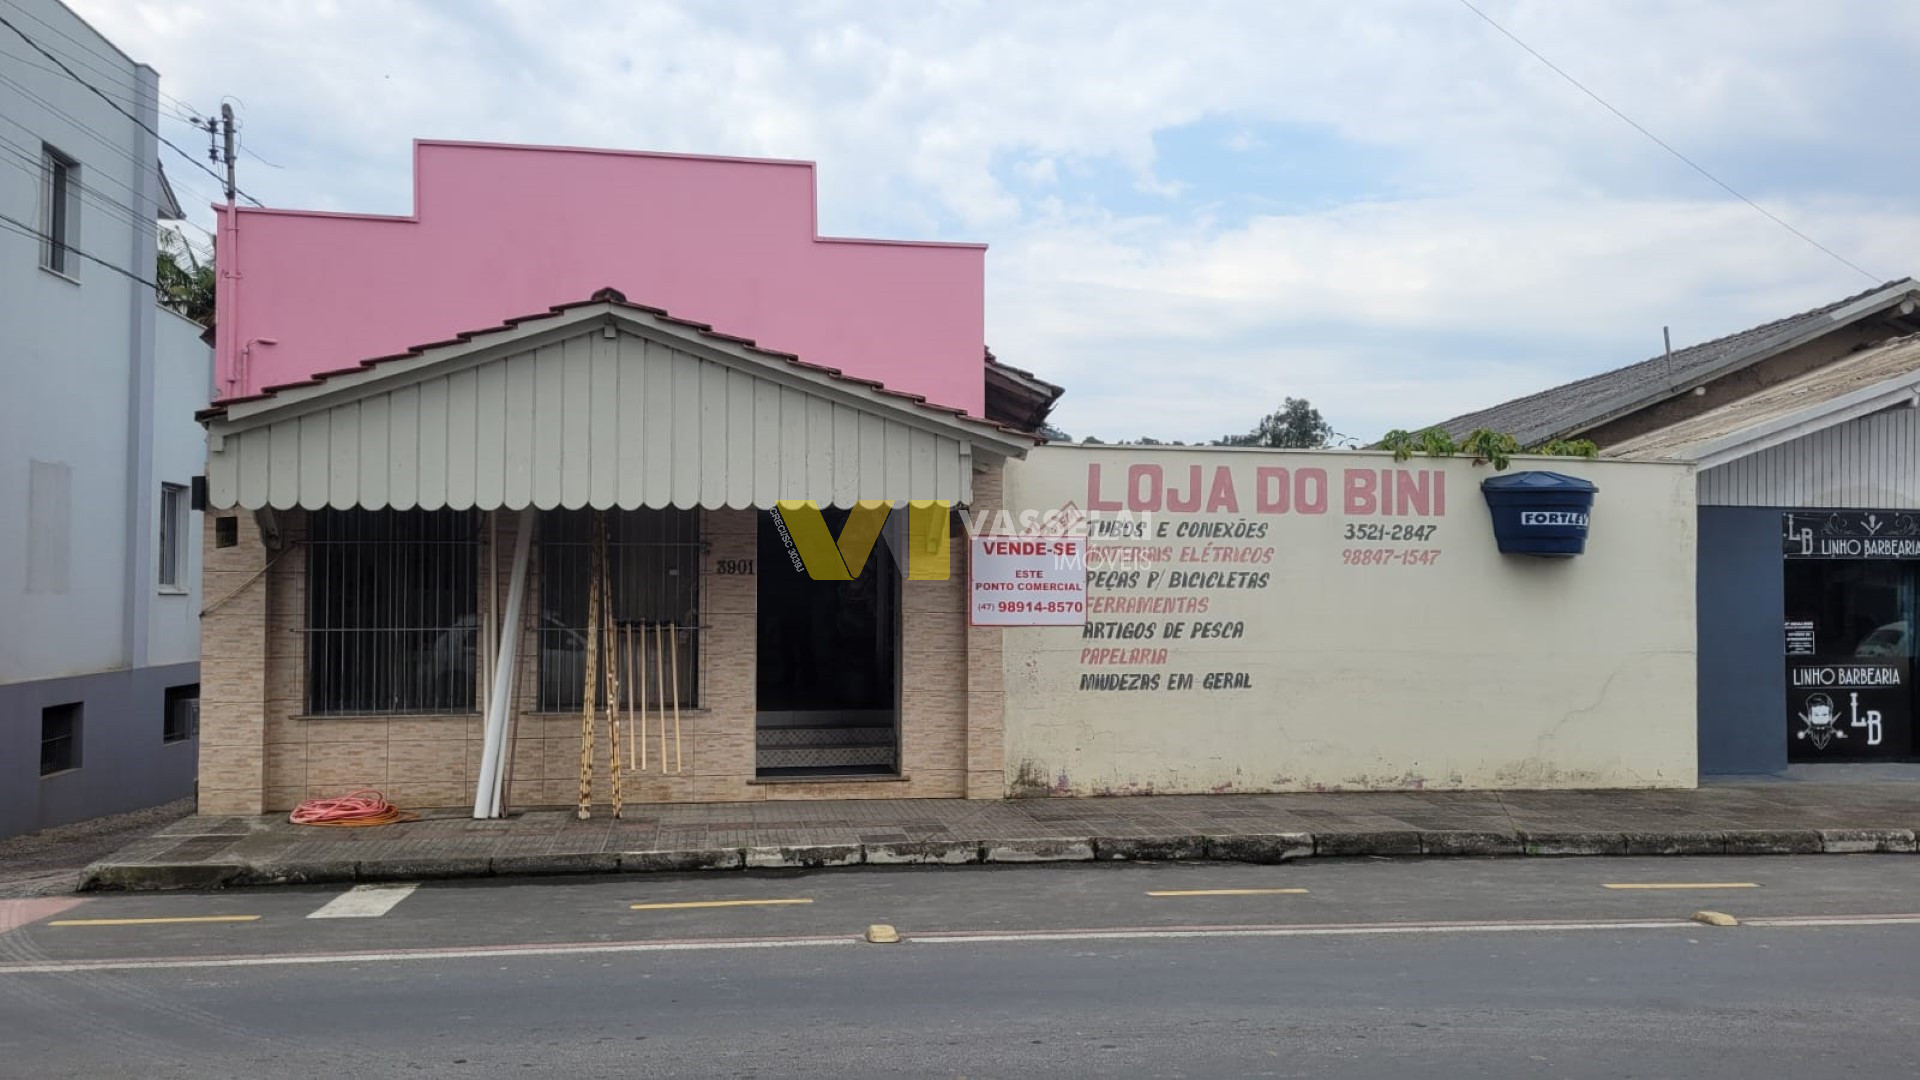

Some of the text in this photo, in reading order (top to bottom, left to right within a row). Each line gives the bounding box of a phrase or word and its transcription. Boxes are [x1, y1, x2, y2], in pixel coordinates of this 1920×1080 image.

[1087, 463, 1446, 517] LOJA DO BINI
[1086, 519, 1147, 539] TUBOS
[1156, 521, 1169, 538] E
[1177, 517, 1269, 539] CONEXÕES
[1343, 523, 1437, 541] 3521-2847
[983, 542, 1077, 556] VENDE-SE
[1180, 541, 1275, 564] ELÉTRICOS
[1821, 539, 1861, 555] LINHO
[1342, 548, 1442, 566] 98847-1547
[717, 560, 754, 575] 3901
[1015, 570, 1044, 579] ESTE
[975, 582, 1082, 591] PONTO COMERCIAL
[1087, 569, 1270, 591] PEÇAS P/ BICICLETAS
[978, 601, 1083, 613] (47) 98914-8570
[1087, 596, 1210, 614] FERRAMENTAS
[1082, 621, 1244, 639] ARTIGOS DE PESCA
[1080, 648, 1168, 665] PAPELARIA
[1079, 672, 1252, 691] MIUDEZAS EM GERAL
[1793, 668, 1901, 685] LINHO BARBEARIA
